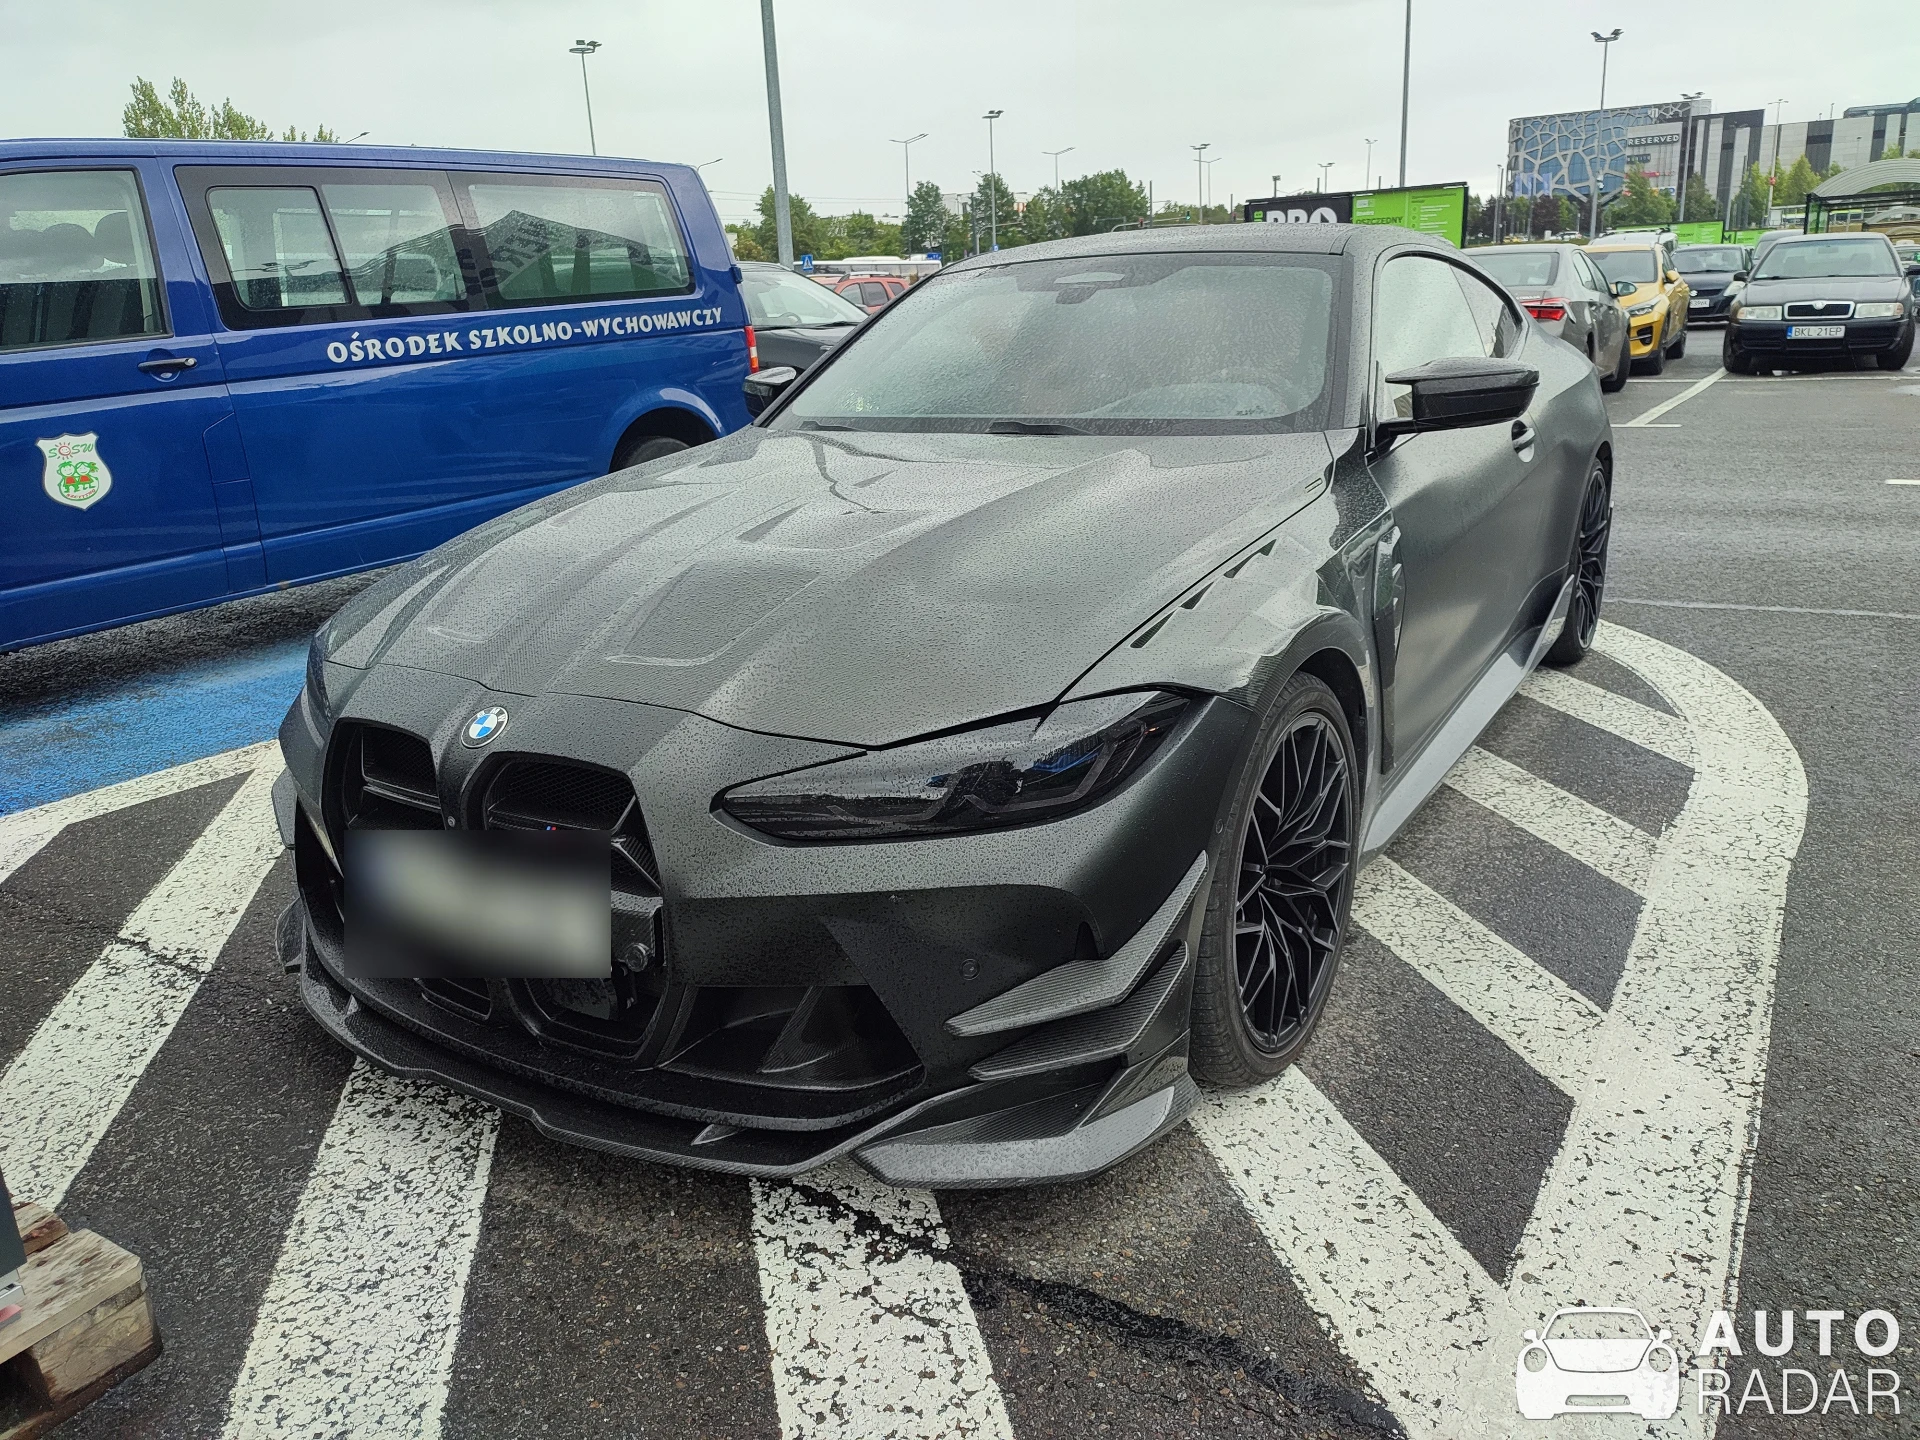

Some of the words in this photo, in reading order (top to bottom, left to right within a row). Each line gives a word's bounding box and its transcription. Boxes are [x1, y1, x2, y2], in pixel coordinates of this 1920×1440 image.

[1628, 134, 1680, 146] RESERVED
[327, 332, 463, 364] OŚRODEK
[470, 307, 722, 350] SZKOLNO-WYCHOWAWCZY
[1794, 327, 1813, 337] BKL
